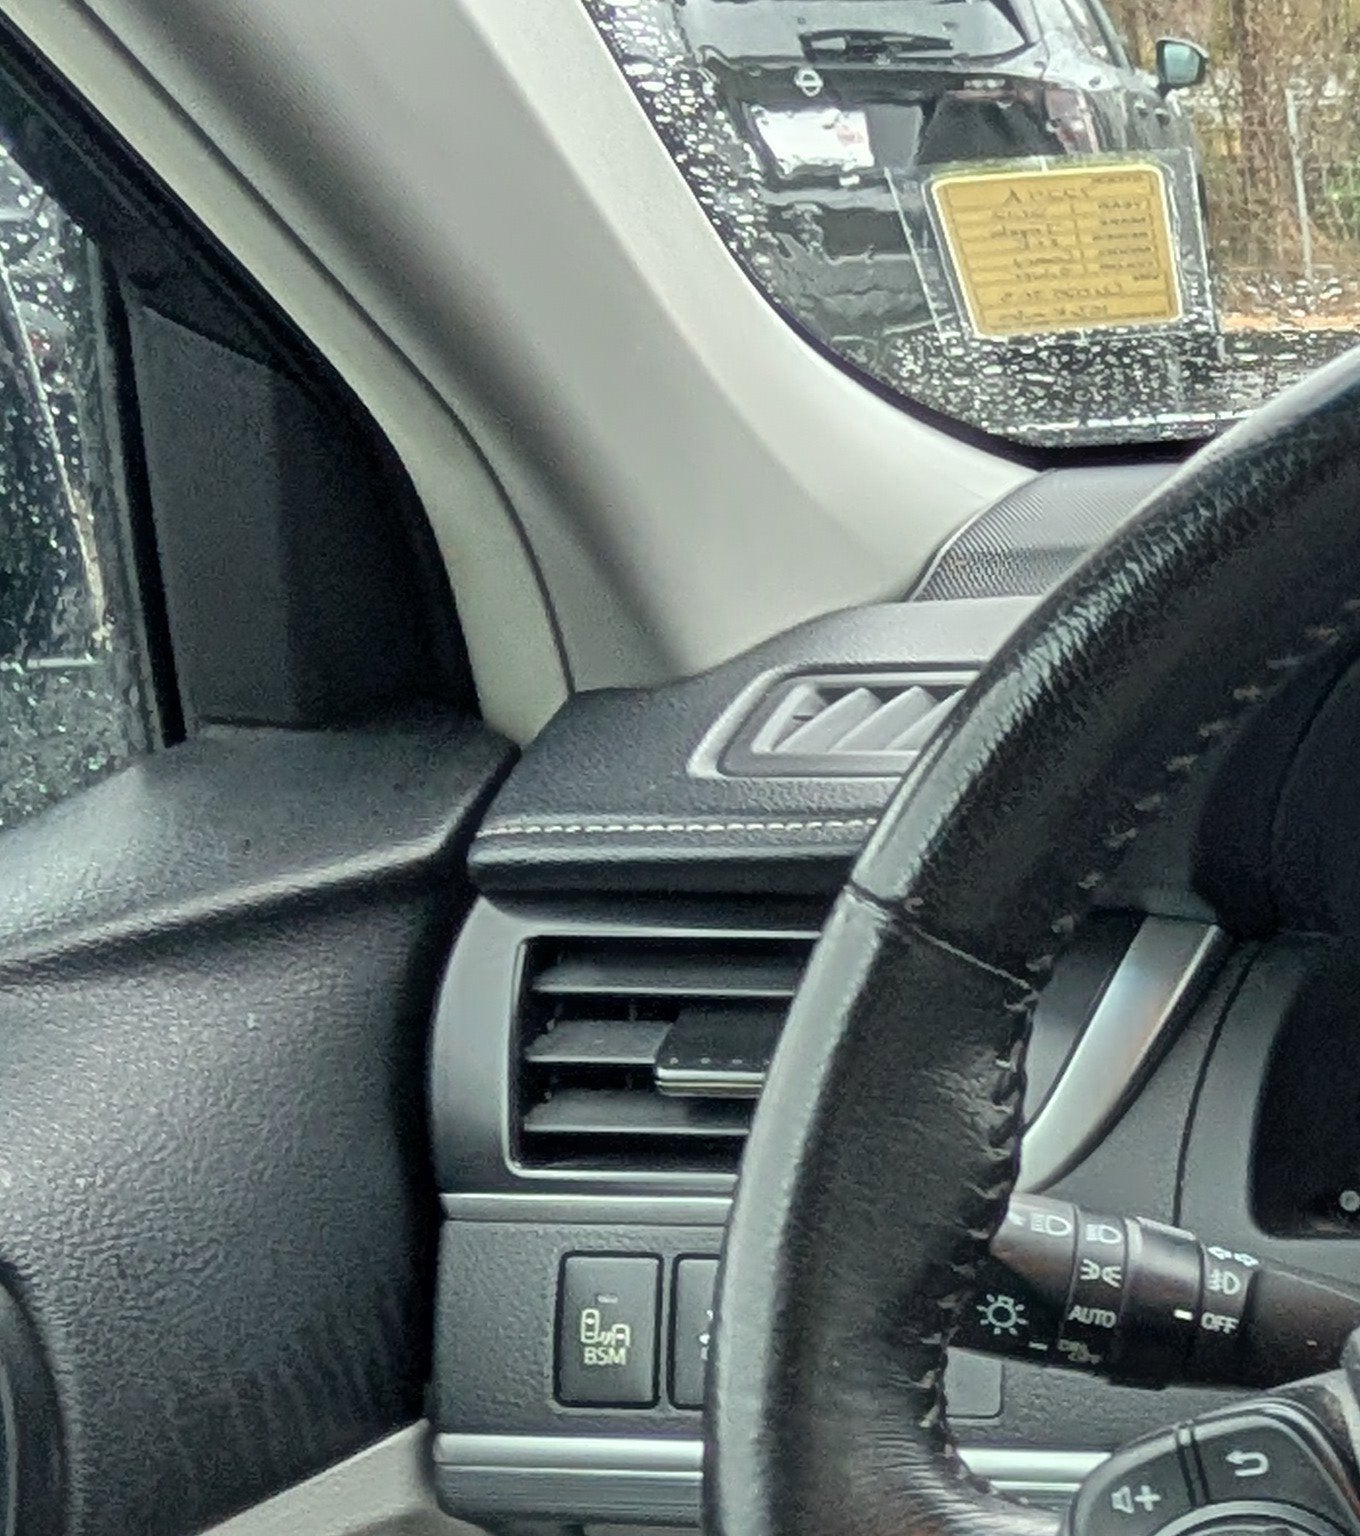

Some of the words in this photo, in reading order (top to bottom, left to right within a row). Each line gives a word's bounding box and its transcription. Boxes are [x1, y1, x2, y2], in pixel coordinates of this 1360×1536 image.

[1067, 1304, 1117, 1329] AUTO
[1200, 1311, 1240, 1335] OFF
[583, 1346, 628, 1366] BSM
